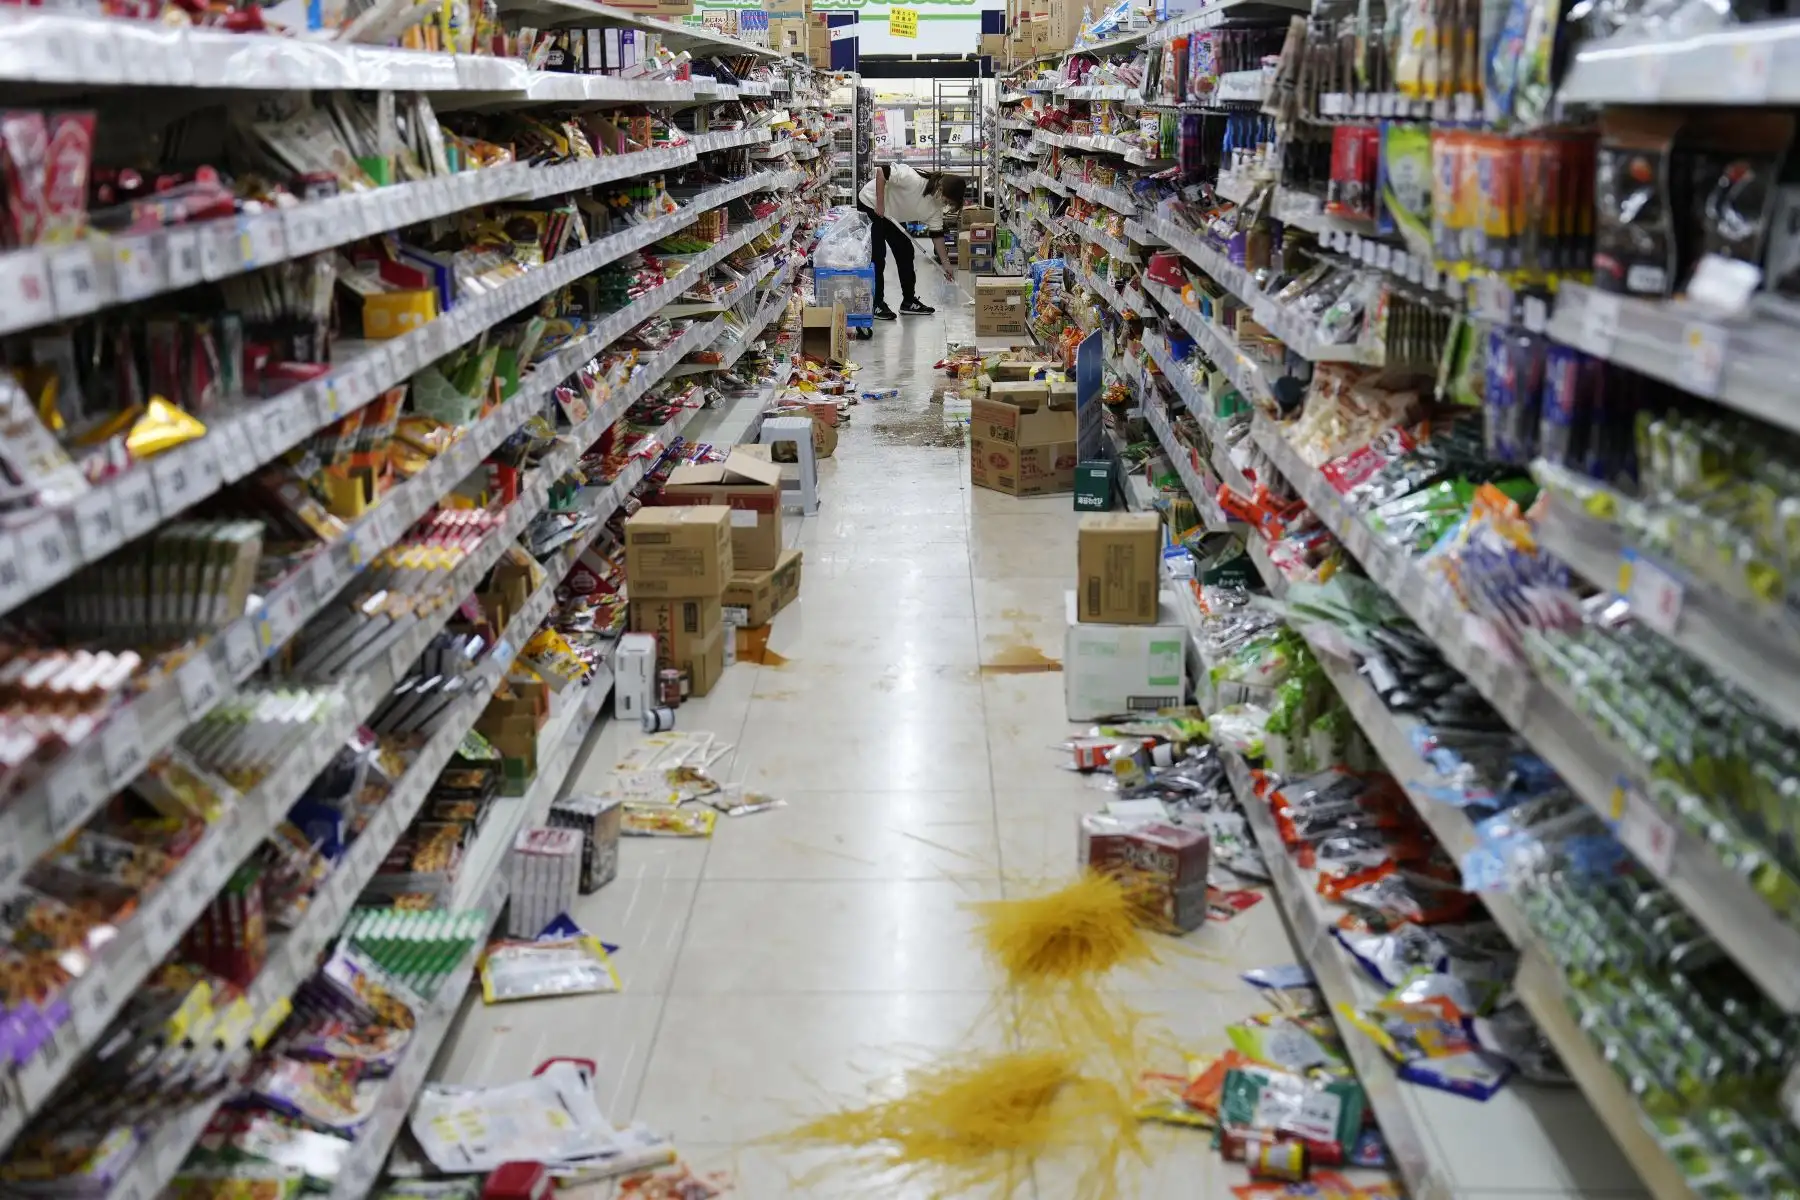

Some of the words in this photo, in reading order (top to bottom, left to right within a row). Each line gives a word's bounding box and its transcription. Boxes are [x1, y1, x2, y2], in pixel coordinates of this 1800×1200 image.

[875, 135, 887, 144] 99
[983, 304, 1017, 312] ジャスミン茶
